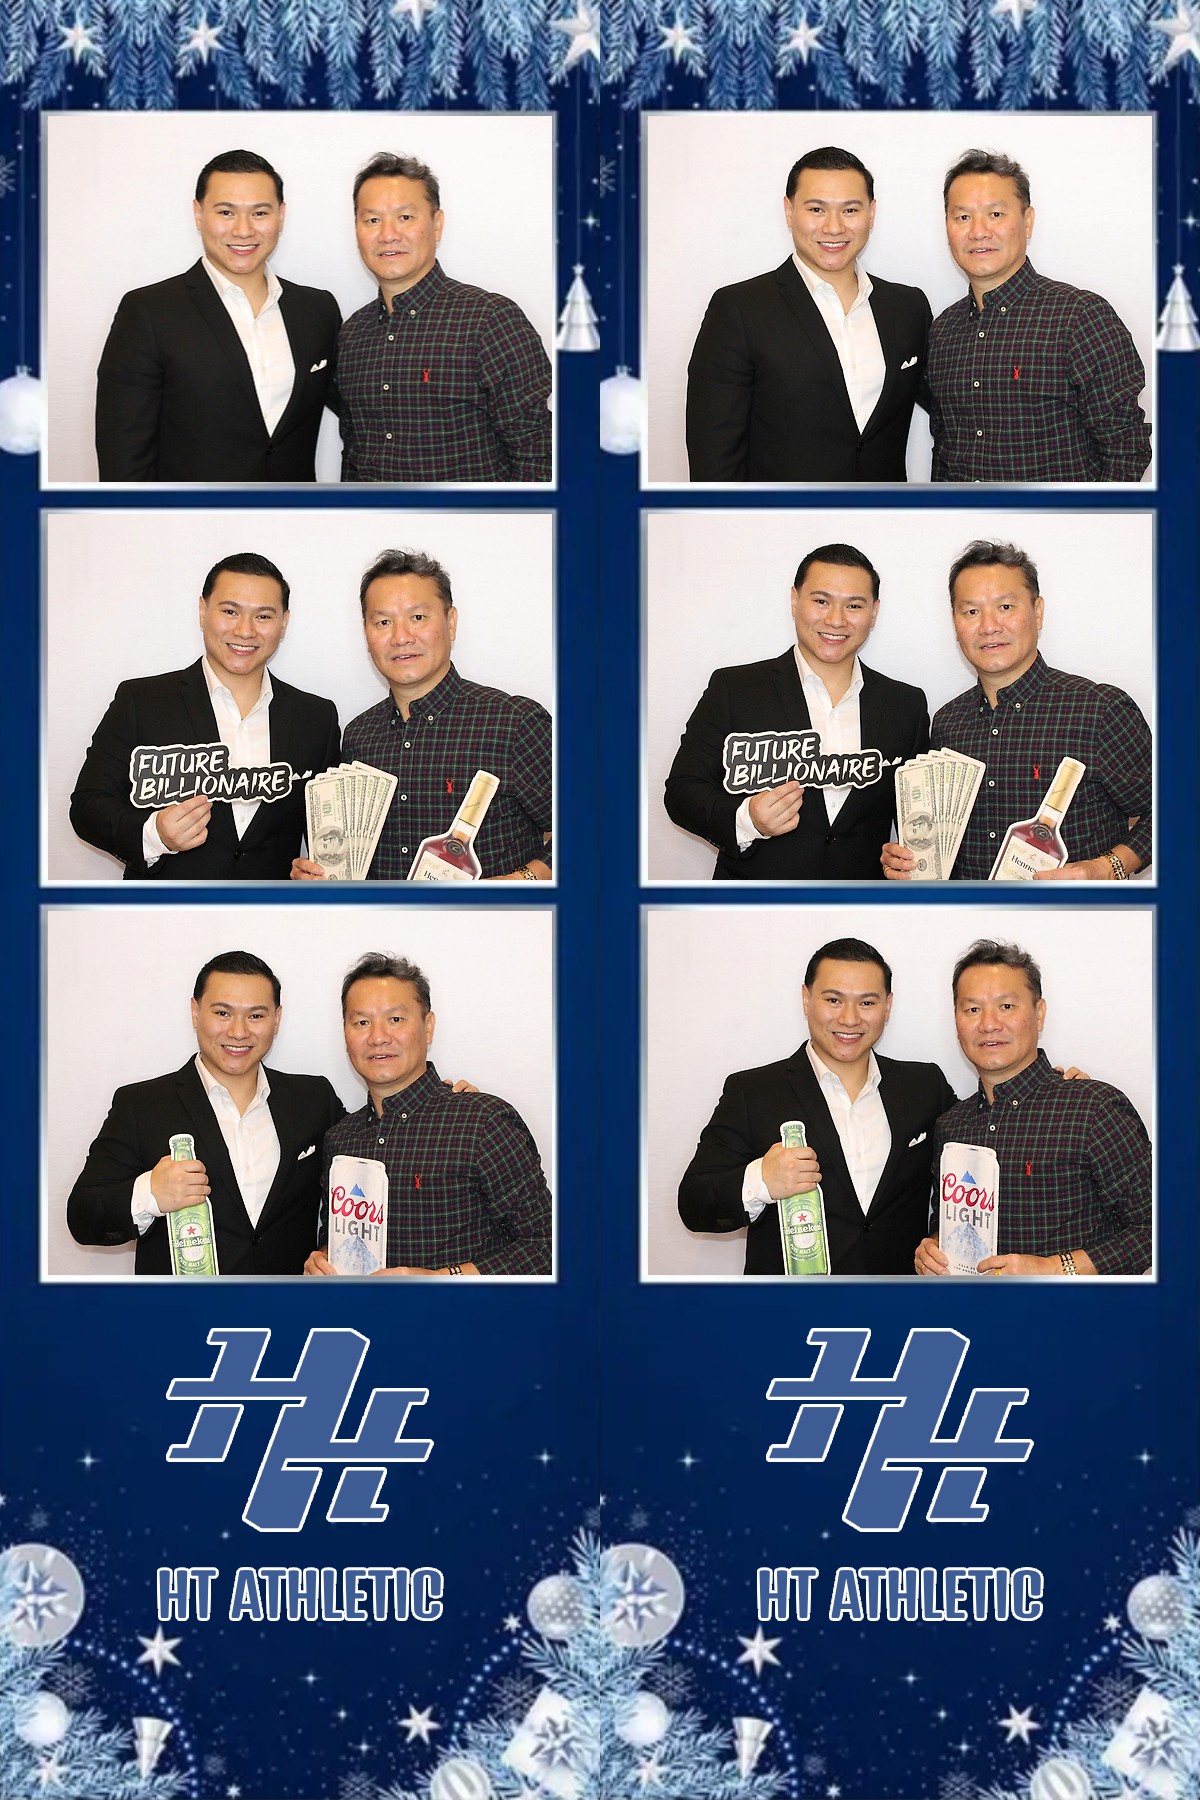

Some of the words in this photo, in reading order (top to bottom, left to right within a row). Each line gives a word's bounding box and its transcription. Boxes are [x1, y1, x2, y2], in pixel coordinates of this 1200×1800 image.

[138, 750, 225, 777] FUTURE
[731, 737, 816, 763] FUTURE
[139, 770, 286, 800] BILLIONAIRE
[732, 757, 876, 786] BILLIONAIRE
[331, 1186, 384, 1225] Coors
[942, 1172, 995, 1212] Coors
[335, 1217, 380, 1242] LIGHT
[946, 1204, 991, 1229] LIGHT
